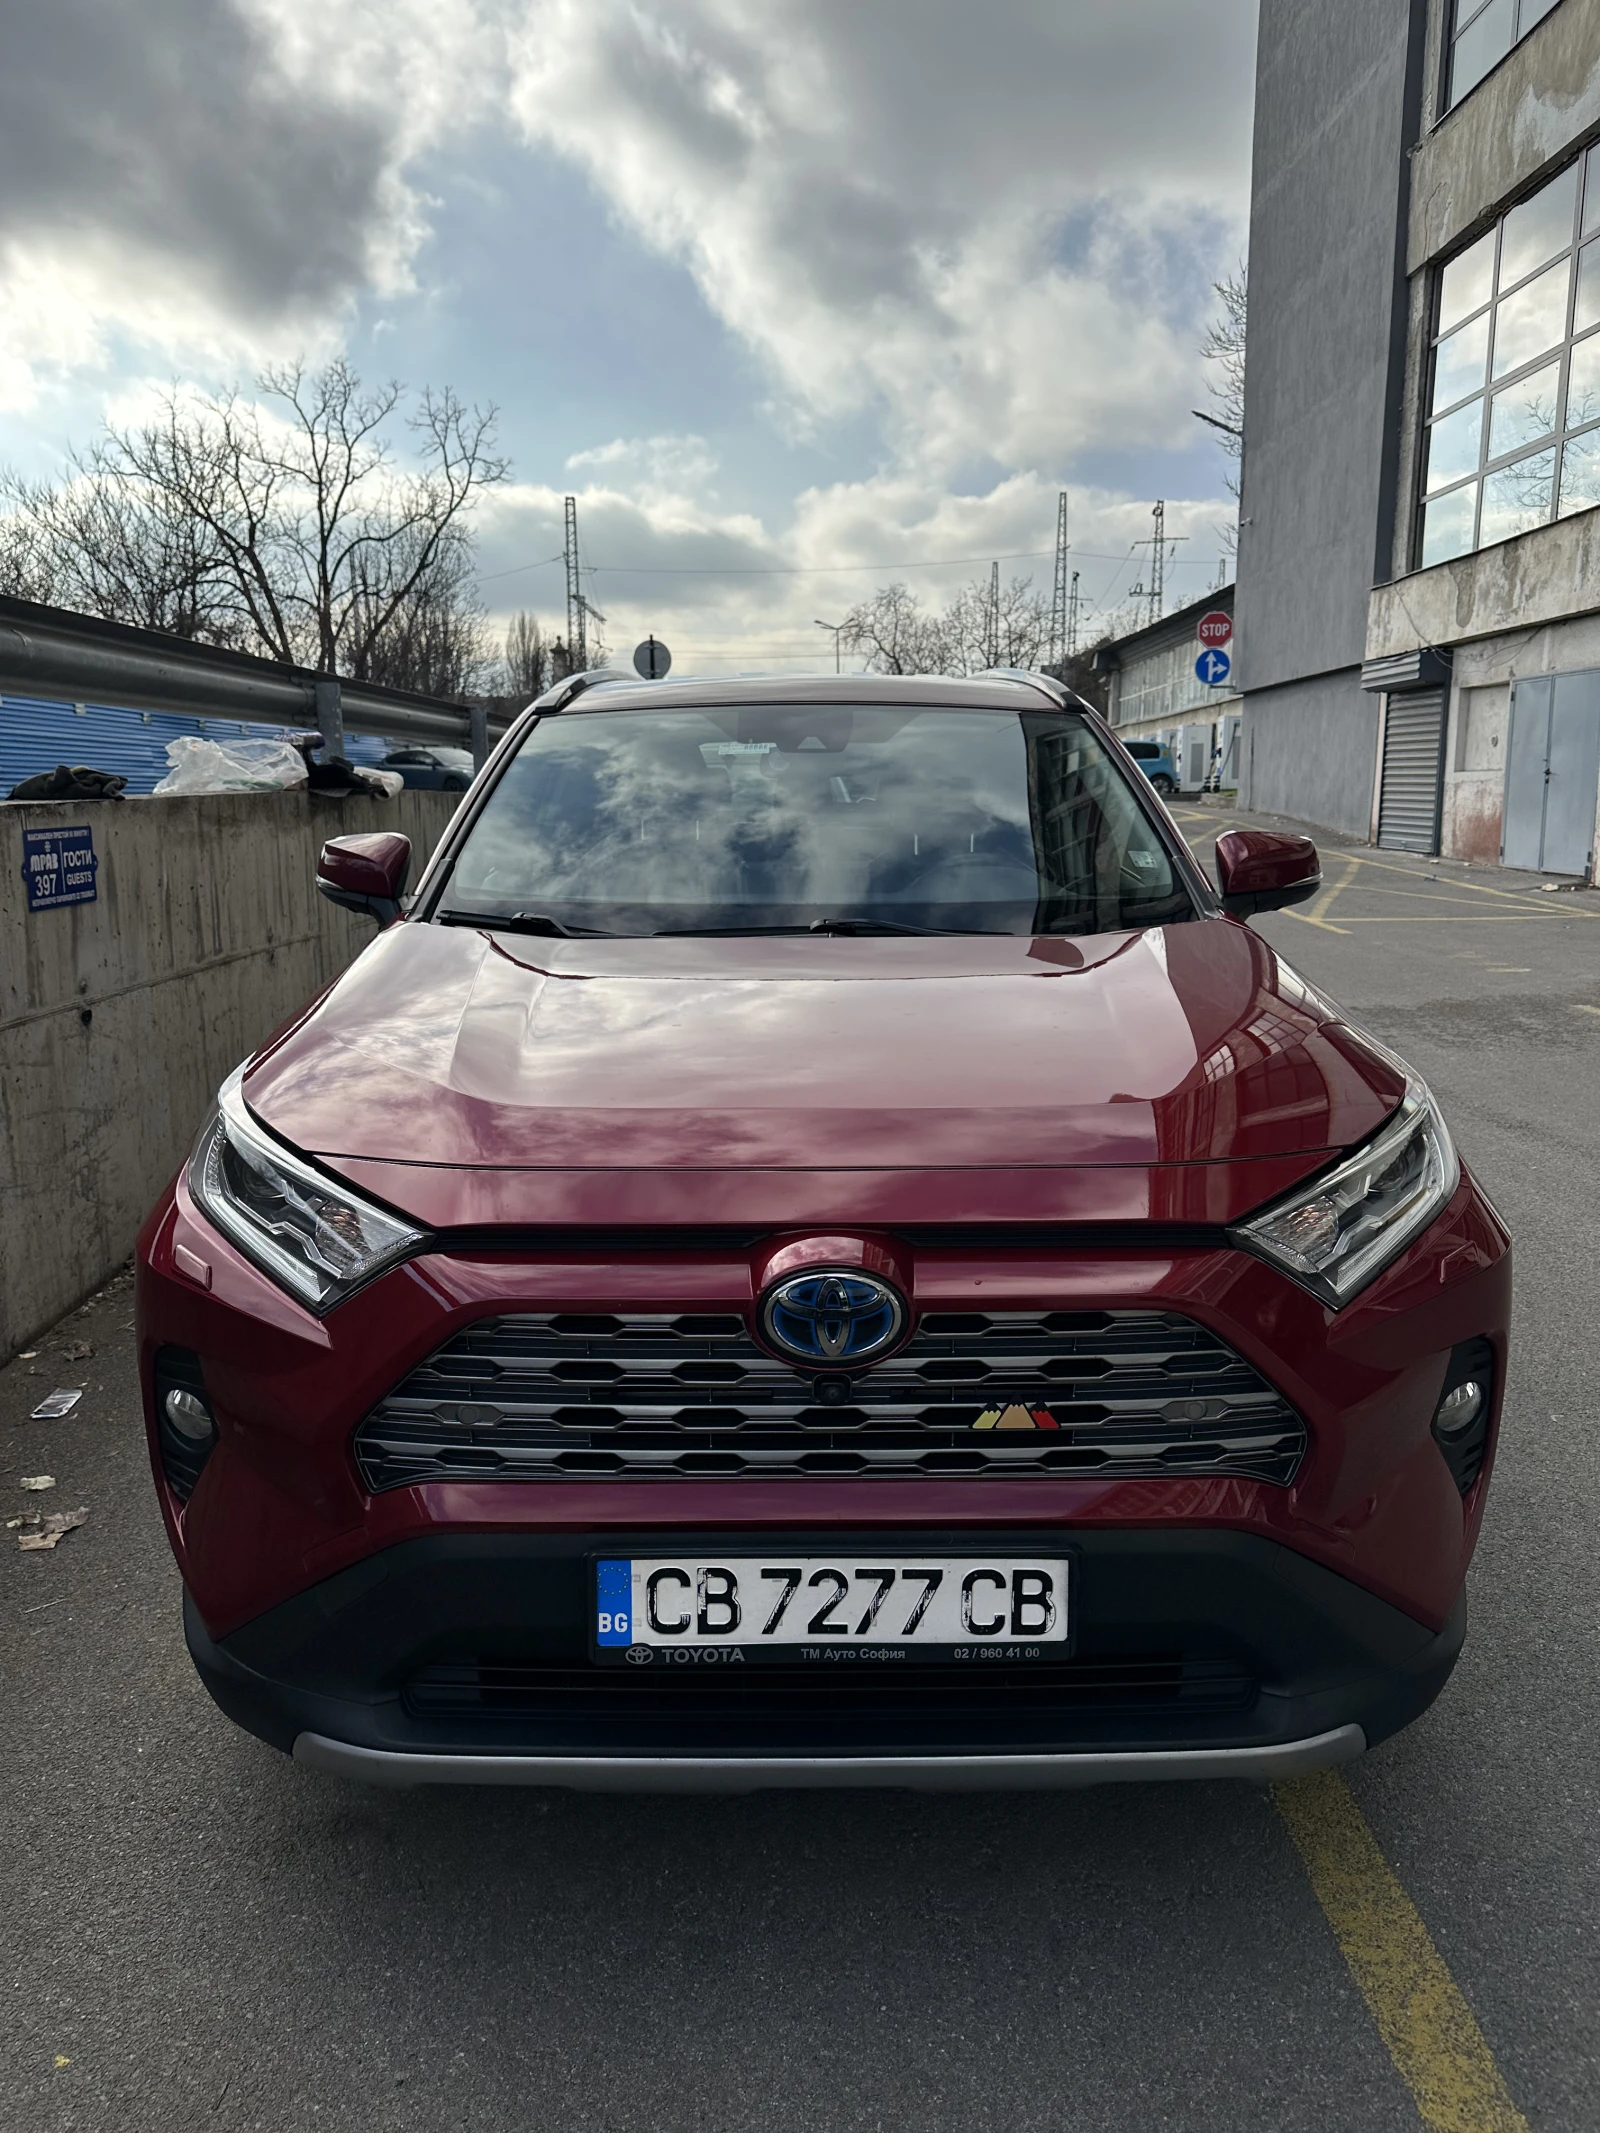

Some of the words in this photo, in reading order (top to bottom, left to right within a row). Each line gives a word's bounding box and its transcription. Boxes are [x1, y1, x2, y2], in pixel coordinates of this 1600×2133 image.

[1201, 623, 1230, 637] STOP
[63, 849, 92, 868] ГОСТИ
[35, 874, 57, 897] 397
[66, 871, 92, 885] GUESTS
[646, 1567, 741, 1635] CB
[760, 1567, 943, 1635] 7277
[961, 1568, 1056, 1636] CB
[598, 1613, 628, 1633] BG
[662, 1648, 745, 1664] TOYOTA
[824, 1649, 856, 1663] Ауто
[860, 1648, 906, 1663] София
[954, 1648, 969, 1659] 02
[980, 1648, 1003, 1659] 960
[1006, 1647, 1020, 1658] 41
[1025, 1647, 1040, 1658] 00
